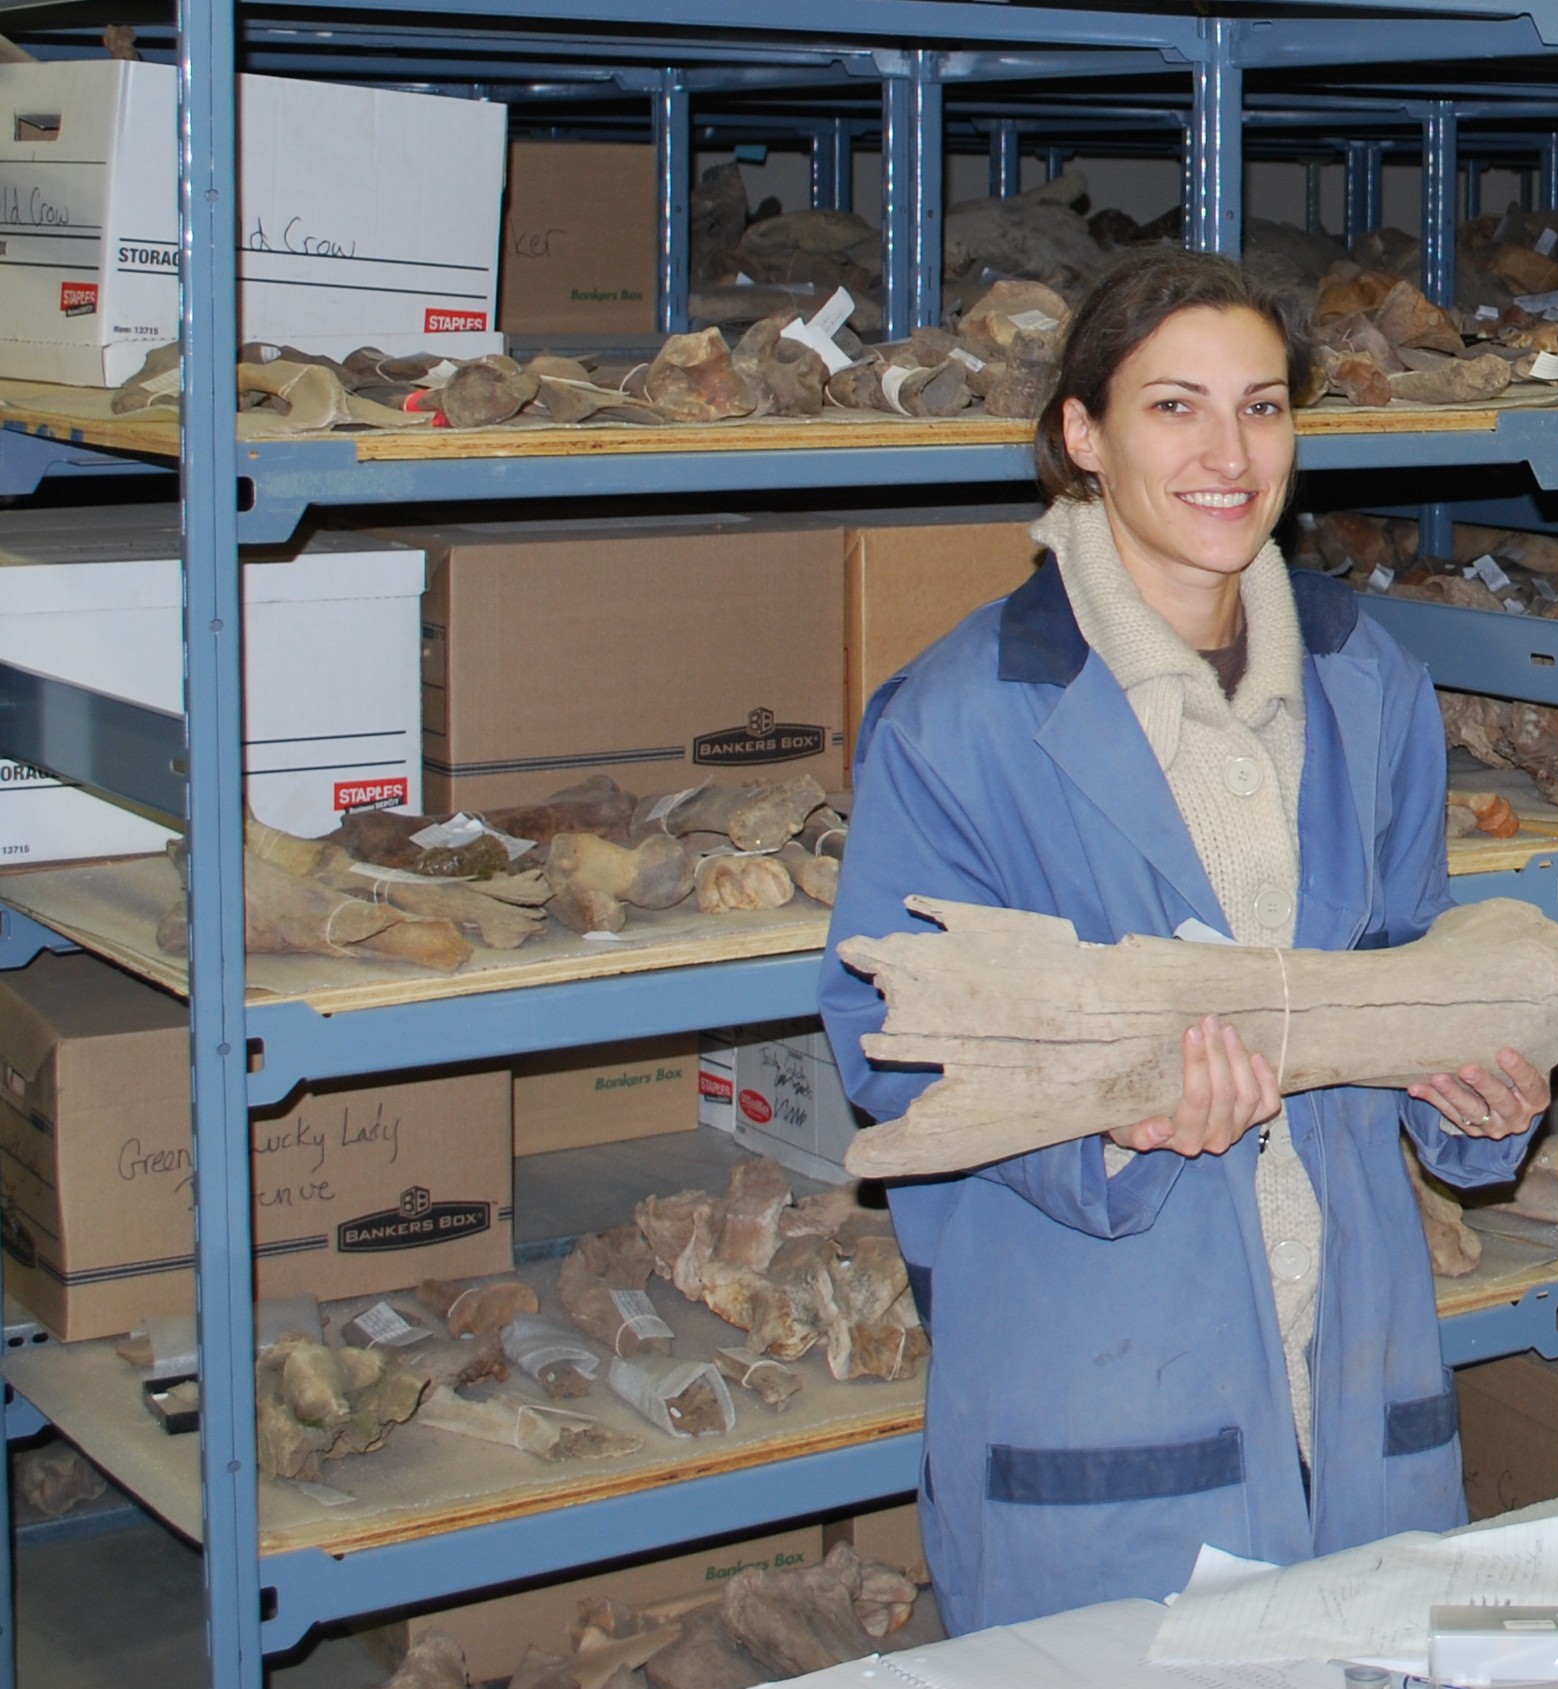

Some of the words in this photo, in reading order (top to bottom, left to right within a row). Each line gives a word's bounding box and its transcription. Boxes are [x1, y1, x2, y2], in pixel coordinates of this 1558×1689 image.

[31, 186, 69, 226] Crow
[284, 216, 356, 258] Crow
[621, 288, 643, 300] Box
[134, 325, 159, 336] 13715
[429, 315, 484, 331] STAPLES
[700, 738, 777, 756] BANKERS
[339, 784, 404, 805] STAPLES
[2, 844, 31, 856] 13715
[594, 1071, 652, 1091] Bankers
[655, 1066, 683, 1082] Box
[341, 1102, 400, 1164] Lady
[345, 1218, 434, 1244] BANKERS
[775, 1552, 805, 1568] Box
